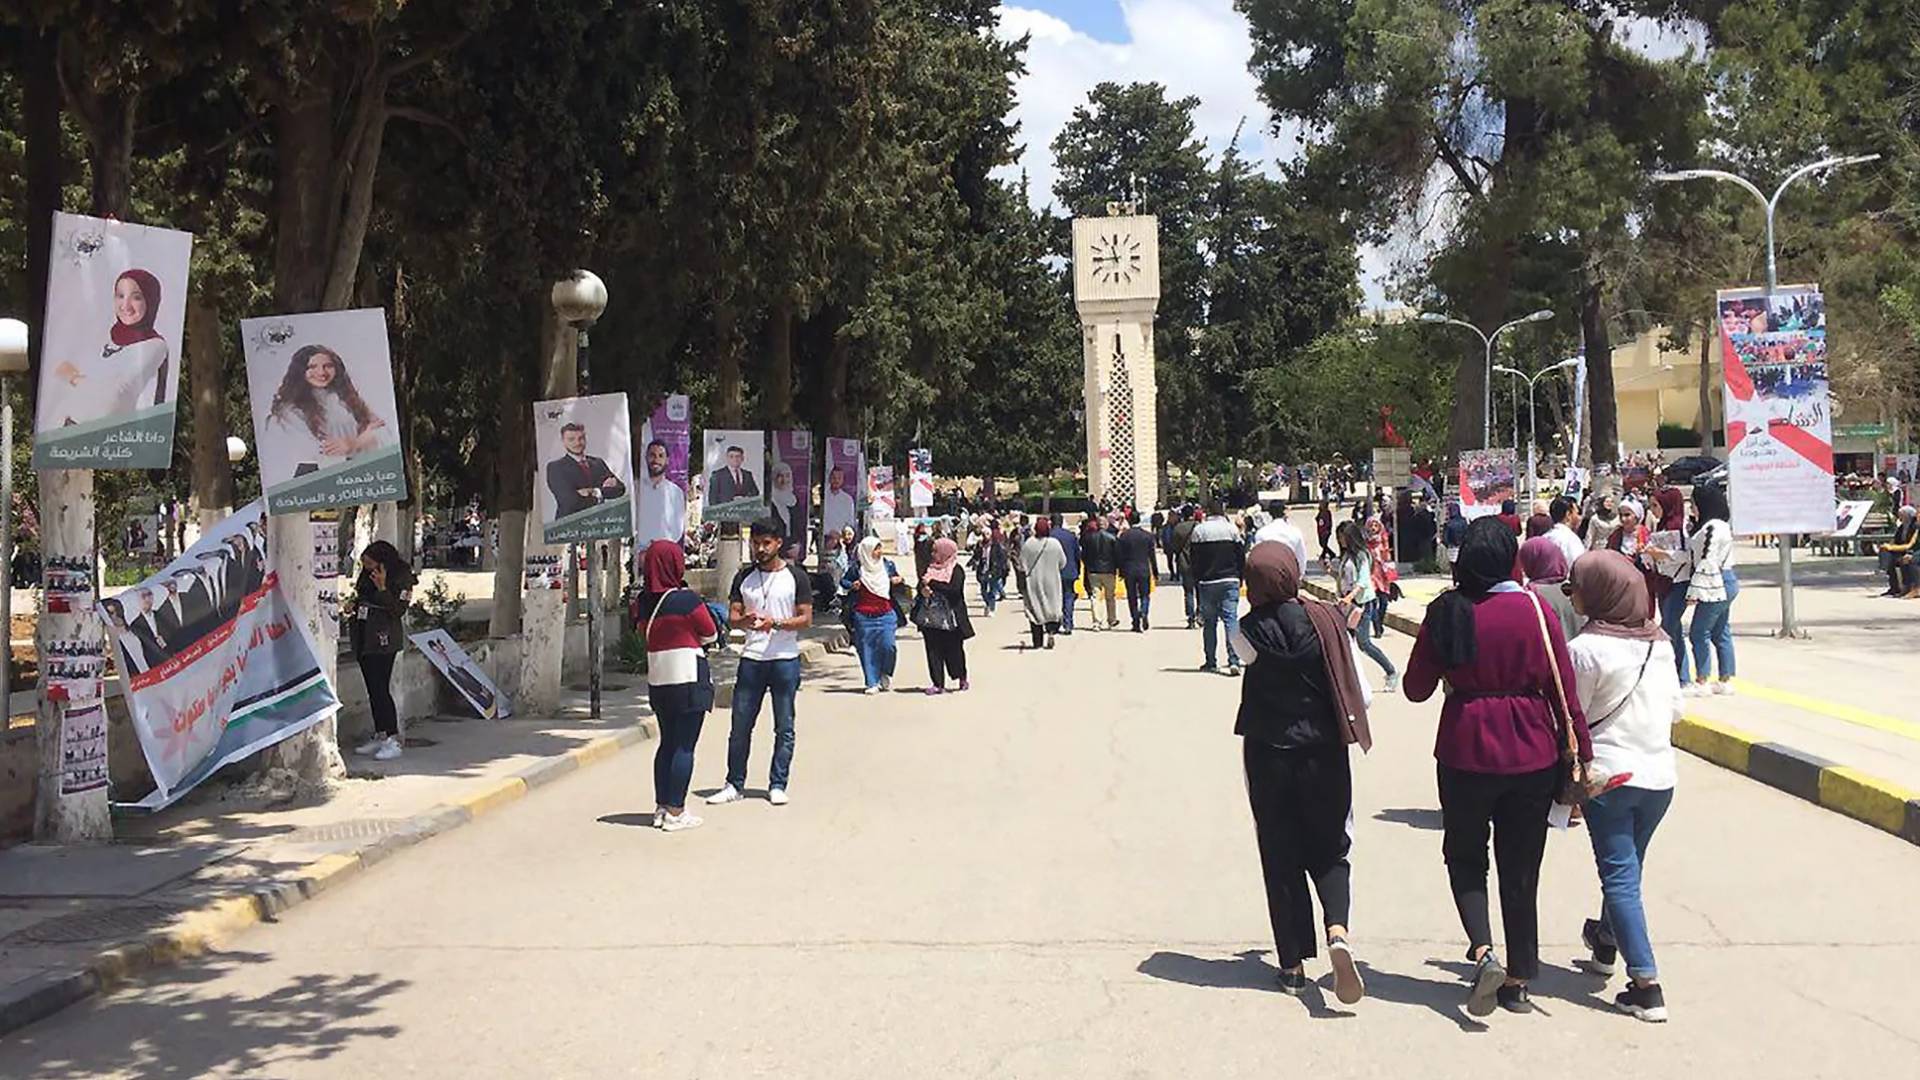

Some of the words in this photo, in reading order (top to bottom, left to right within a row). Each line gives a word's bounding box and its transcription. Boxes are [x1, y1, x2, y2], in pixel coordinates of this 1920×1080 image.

[49, 446, 100, 460] الشريعة
[101, 446, 133, 461] كلية
[366, 484, 398, 499] كلية
